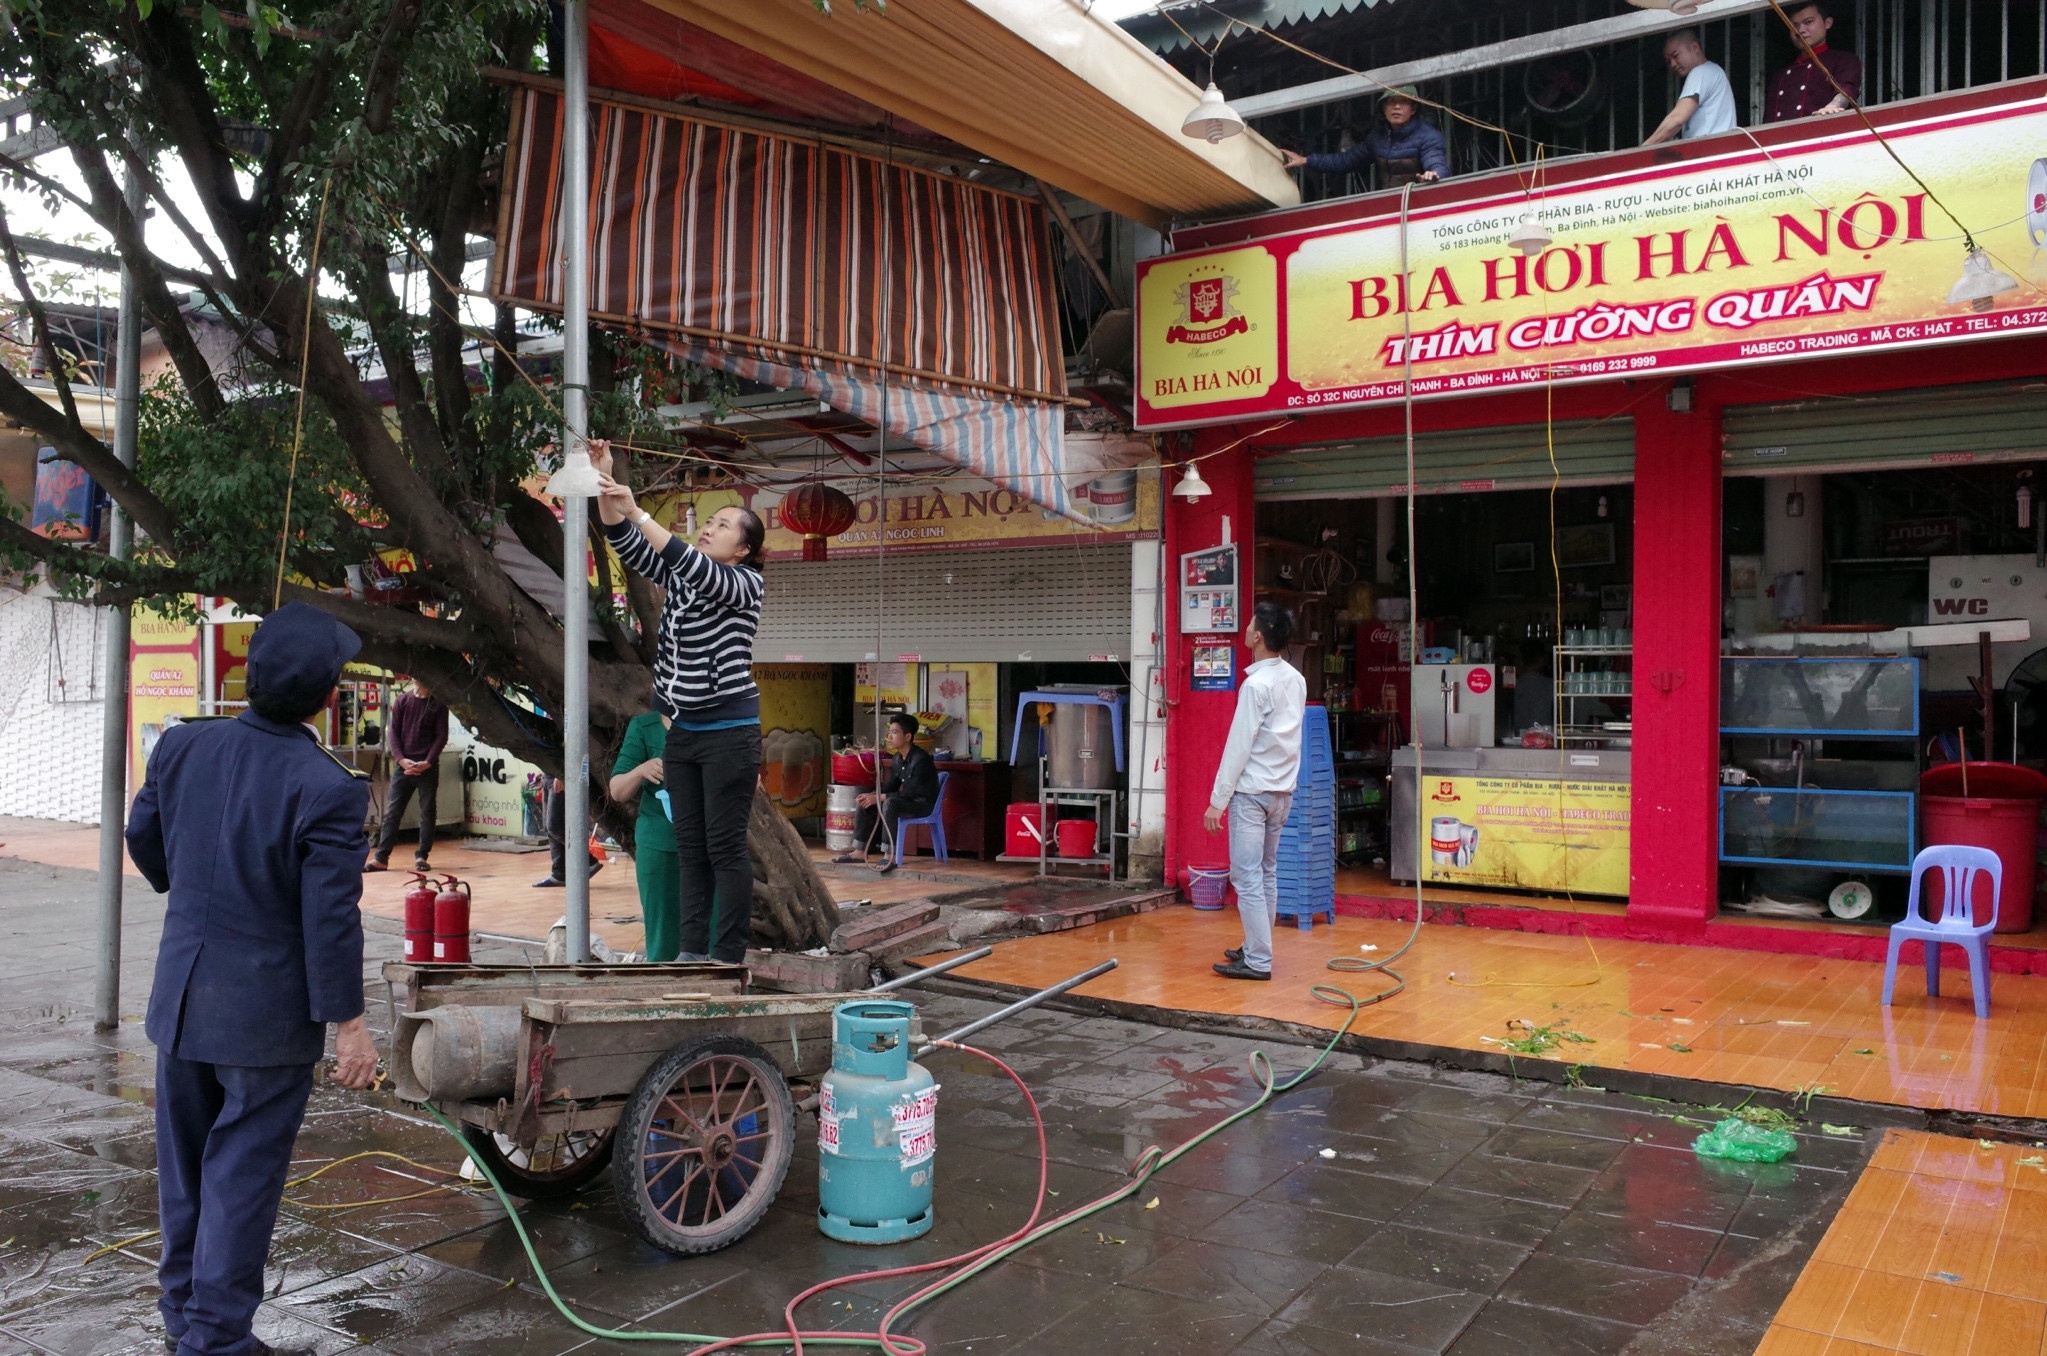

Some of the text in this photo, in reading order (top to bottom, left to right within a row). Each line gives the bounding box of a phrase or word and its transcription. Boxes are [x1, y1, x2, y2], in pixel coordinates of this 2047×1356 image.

[1433, 224, 1463, 239] TỔNG
[1467, 214, 1499, 234] CÔNG
[1502, 215, 1516, 229] TY
[1538, 205, 1572, 221] PHẦN
[1575, 202, 1594, 215] BIA
[1604, 193, 1642, 211] RƯỢU
[1653, 186, 1692, 203] NƯỚC
[1696, 177, 1722, 195] GIẢI
[1726, 173, 1760, 190] KHÁT
[1764, 169, 1783, 184] HÀ
[1787, 164, 1813, 181] NỘI
[1439, 240, 1451, 252] Số
[1454, 237, 1469, 249] 183
[1471, 234, 1501, 248] Hoàng
[1558, 222, 1569, 233] Ba
[1602, 214, 1616, 226] Hà
[1623, 211, 1637, 224] Nội
[1645, 204, 1691, 219] Website:
[1693, 186, 1804, 211] biahoihanoi.com.vn
[1347, 190, 1928, 322] BIA HƠI HÀ NỘI
[1386, 275, 1877, 364] THÍM CƯỜNG QUÁN
[1186, 327, 1227, 342] HABECO
[1740, 338, 1797, 355] HABECO
[1798, 331, 1859, 350] TRADING
[1870, 326, 1893, 343] MÃ
[1896, 325, 1921, 340] CK:
[1924, 321, 1953, 337] HAT
[1966, 317, 1998, 332] TEL:
[1154, 364, 1263, 397] BIA HÀ NỘI
[1287, 396, 1306, 407] ĐC:
[1323, 390, 1341, 402] 32C
[1386, 382, 1404, 394] CHÍ
[1409, 379, 1442, 393] HANH
[1449, 377, 1466, 389] BA
[1467, 373, 1494, 388] ĐÌNH
[1502, 368, 1518, 382] HÀ
[1520, 367, 1541, 383] NỘI
[1579, 361, 1605, 374] 0169
[1608, 358, 1628, 371] 232
[1630, 355, 1657, 369] 9999
[902, 486, 953, 522] HÀ
[838, 528, 867, 544] QUÁN
[886, 527, 918, 543] NGỌC
[920, 526, 945, 538] LINH
[1933, 598, 1989, 616] WC
[141, 623, 156, 634] BIA
[150, 668, 182, 681] QUÁN A2
[147, 686, 167, 699] NGỌC
[168, 684, 194, 696] KHÁNH
[482, 814, 507, 827] khoai
[1477, 805, 1493, 815] BIA
